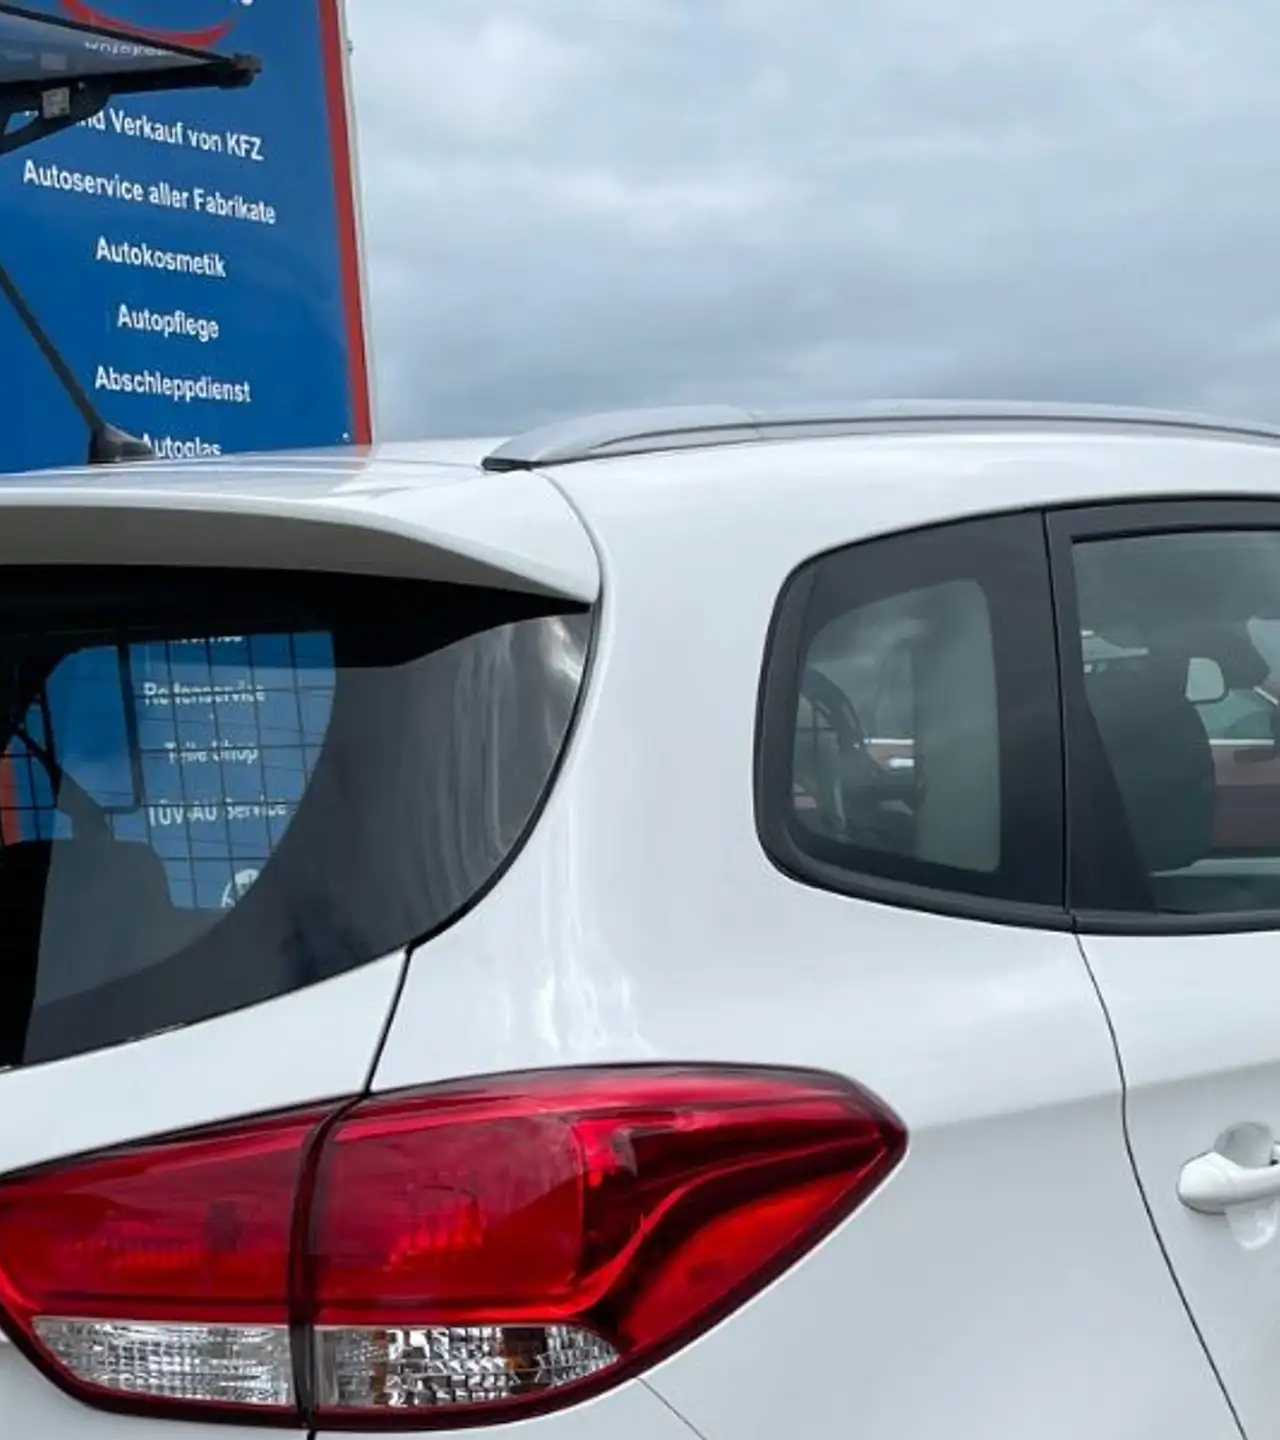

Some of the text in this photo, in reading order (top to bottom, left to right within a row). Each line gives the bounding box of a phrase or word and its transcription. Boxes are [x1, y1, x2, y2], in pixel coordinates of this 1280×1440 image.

[106, 107, 184, 145] Verkauf
[186, 129, 223, 153] von
[227, 132, 265, 162] KFZ
[23, 159, 277, 225] Autoservice aller Fabrikate
[95, 237, 228, 278] Autokosmetik
[116, 303, 220, 342] Autopflege
[94, 365, 253, 403] Abschleppdienst
